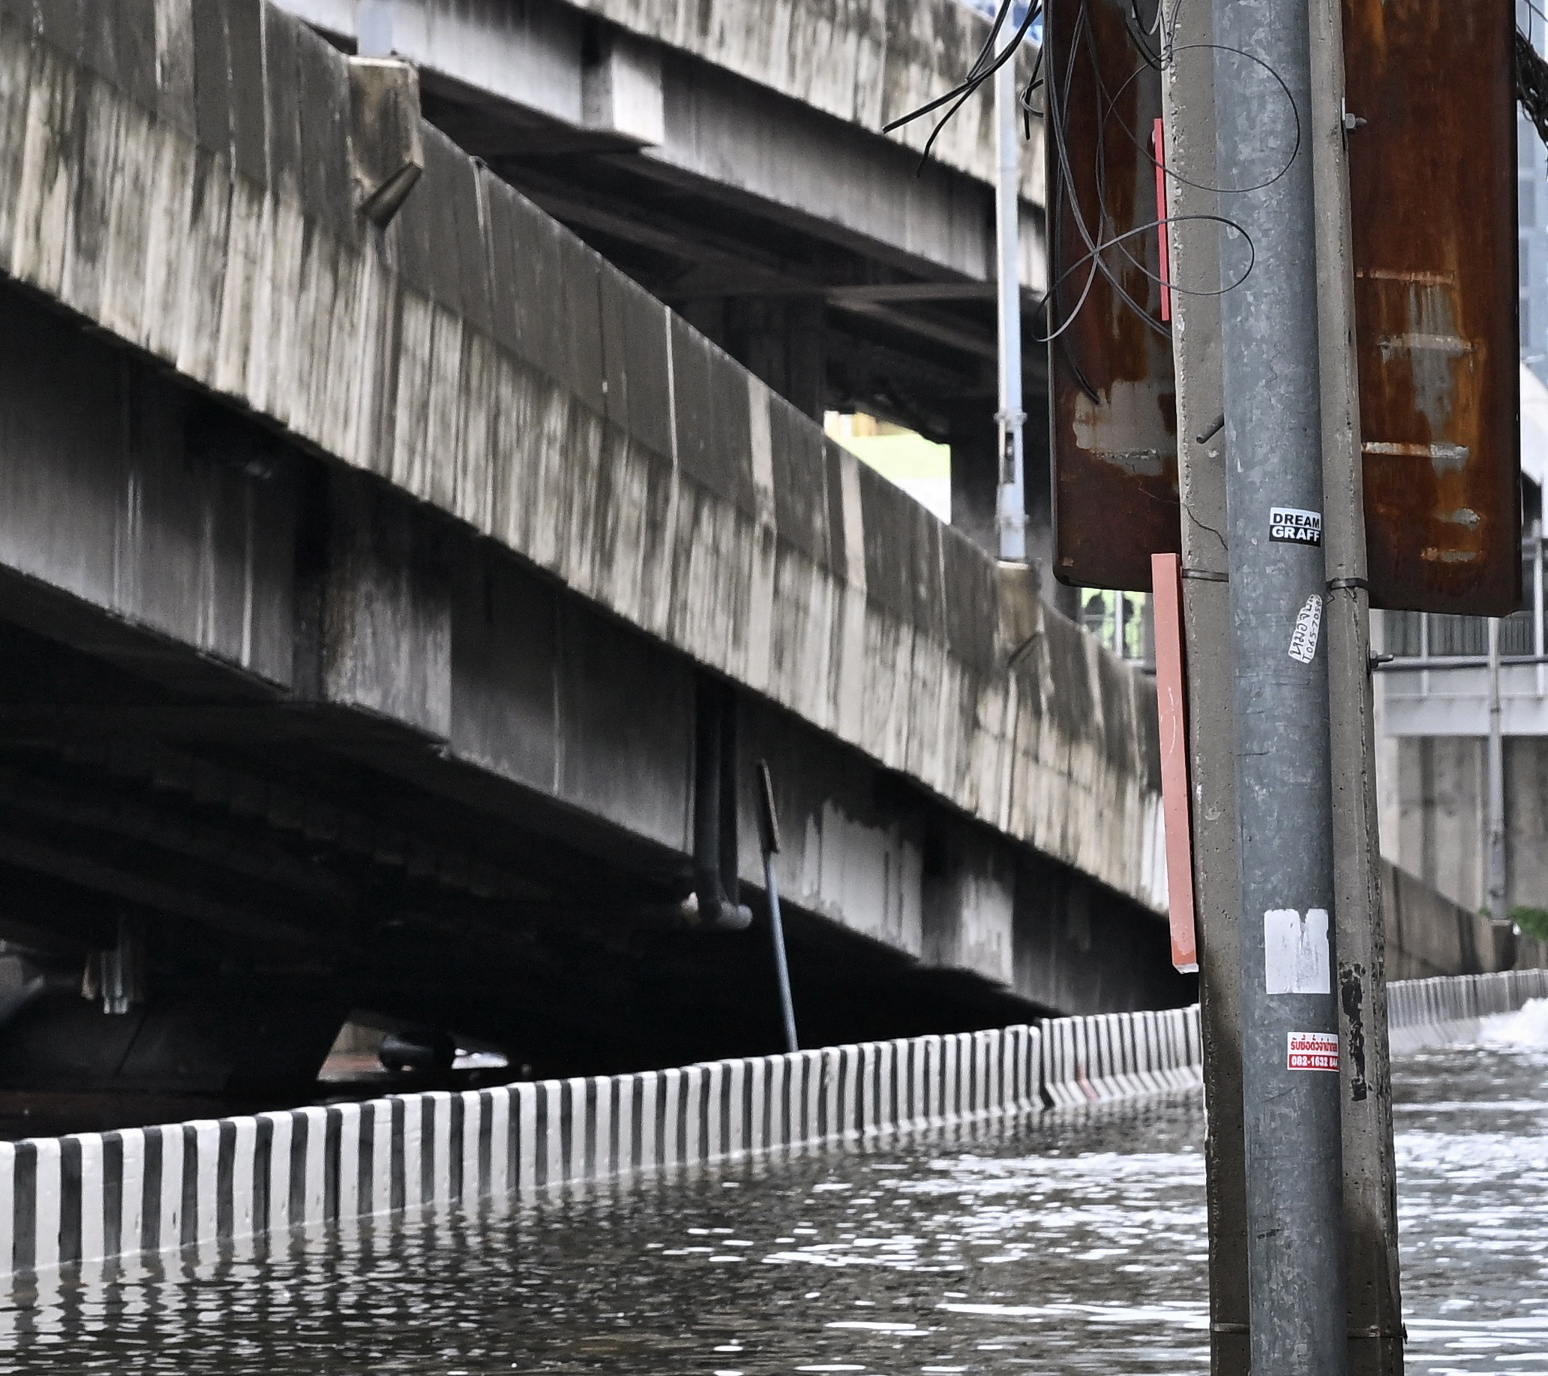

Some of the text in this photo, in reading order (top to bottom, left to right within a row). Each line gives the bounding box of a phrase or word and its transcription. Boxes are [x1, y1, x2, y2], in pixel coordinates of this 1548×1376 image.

[1273, 513, 1320, 529] DREAM
[1271, 526, 1320, 542] GRAFF
[1291, 1055, 1328, 1067] 082-1632
